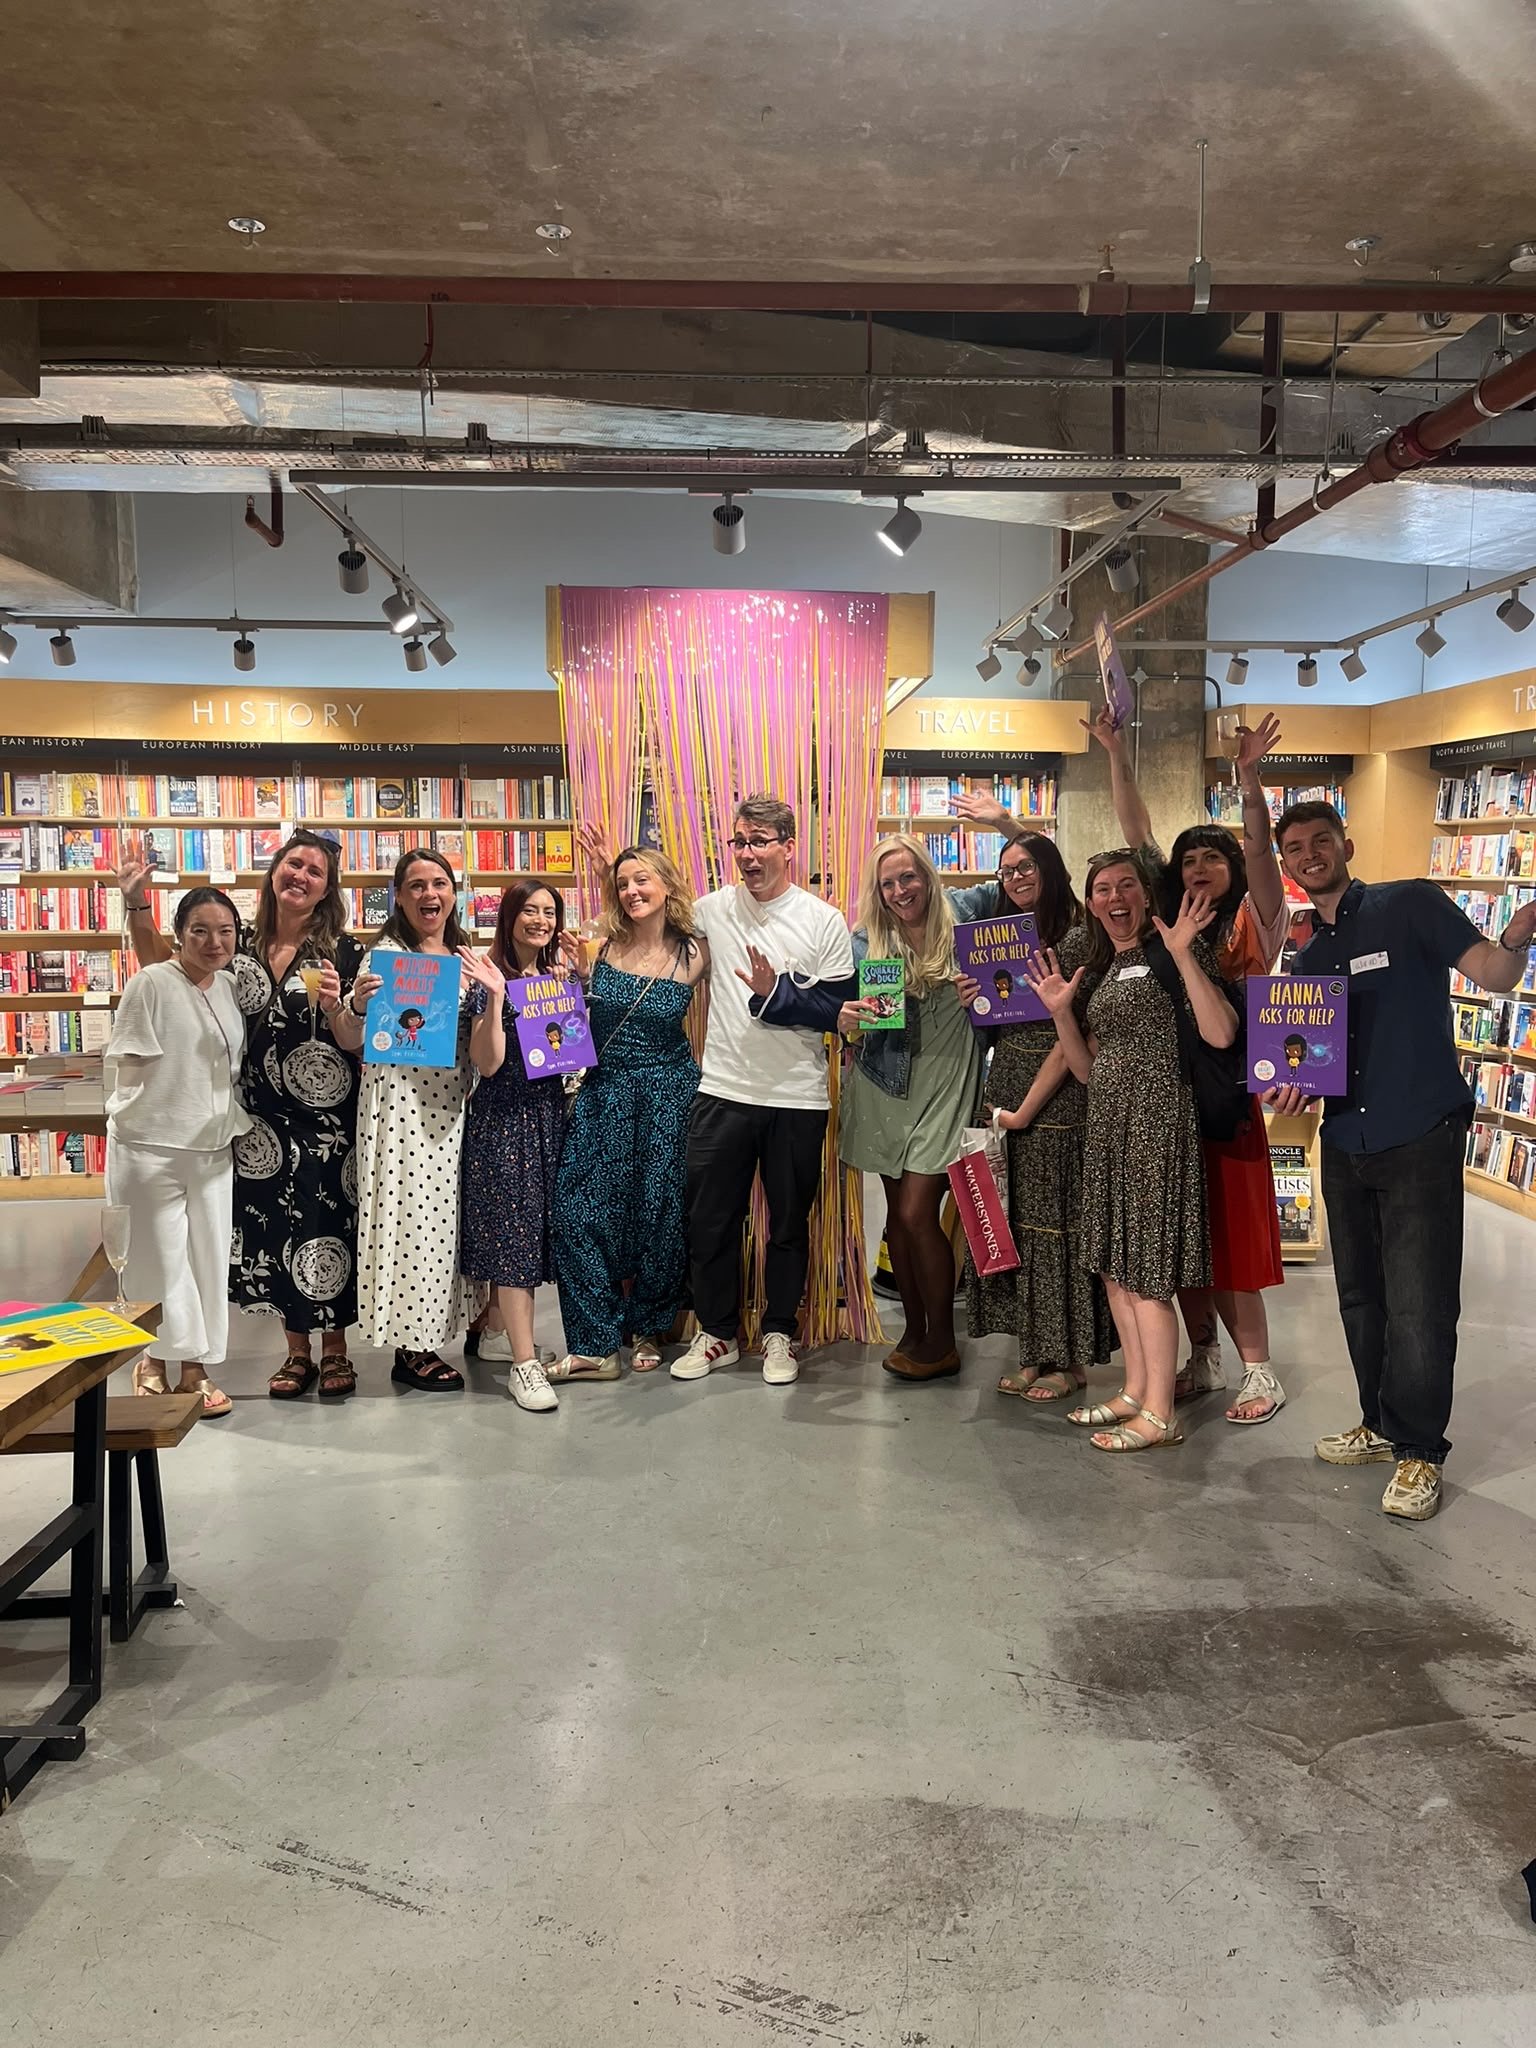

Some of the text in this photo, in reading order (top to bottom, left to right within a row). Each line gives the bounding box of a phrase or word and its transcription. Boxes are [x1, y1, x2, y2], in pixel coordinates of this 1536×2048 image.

[192, 701, 363, 727] HISTORY
[916, 709, 1016, 734] TRAVEL
[32, 738, 86, 747] HISTORY
[142, 740, 263, 750] EUROPEAN HISTORY
[339, 743, 415, 752] MIDDLE EAST
[503, 745, 537, 753] ASIAN
[1436, 740, 1507, 757] NORTH AMERICAN TRAVEL
[941, 751, 1035, 760] EUROPEAN TRAVEL
[1297, 755, 1329, 763] TRAVEL
[170, 781, 196, 791] STRAITS
[377, 835, 400, 846] BATTLE
[546, 854, 571, 864] MAO
[974, 923, 1020, 947] HANNA
[969, 942, 1030, 965] ASKS FOR HELP
[877, 974, 897, 984] DUCK
[526, 978, 566, 1001] HANNA
[1269, 982, 1324, 1005] HANNA
[523, 996, 576, 1019] ASKS FOR HELP
[1259, 1007, 1335, 1025] ASKS FOR HELP
[965, 1164, 1001, 1260] WATERSTONES
